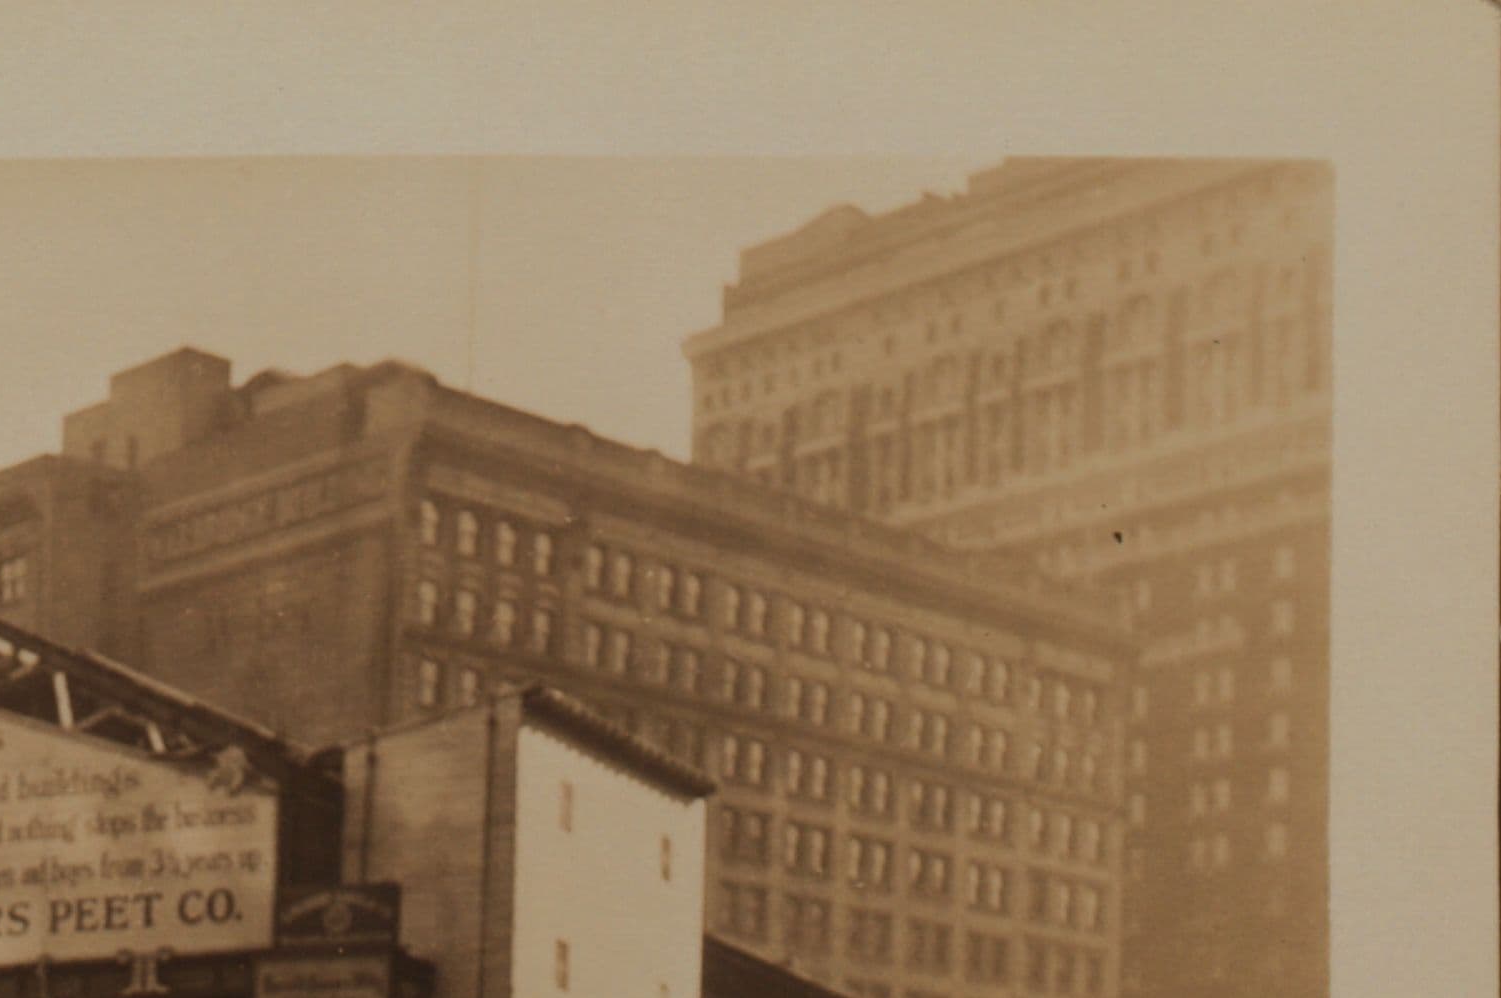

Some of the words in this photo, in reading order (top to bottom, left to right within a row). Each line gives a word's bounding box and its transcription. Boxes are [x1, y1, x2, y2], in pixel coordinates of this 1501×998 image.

[17, 766, 140, 801] buildings
[48, 892, 164, 935] PEET
[176, 887, 243, 927] CO.
